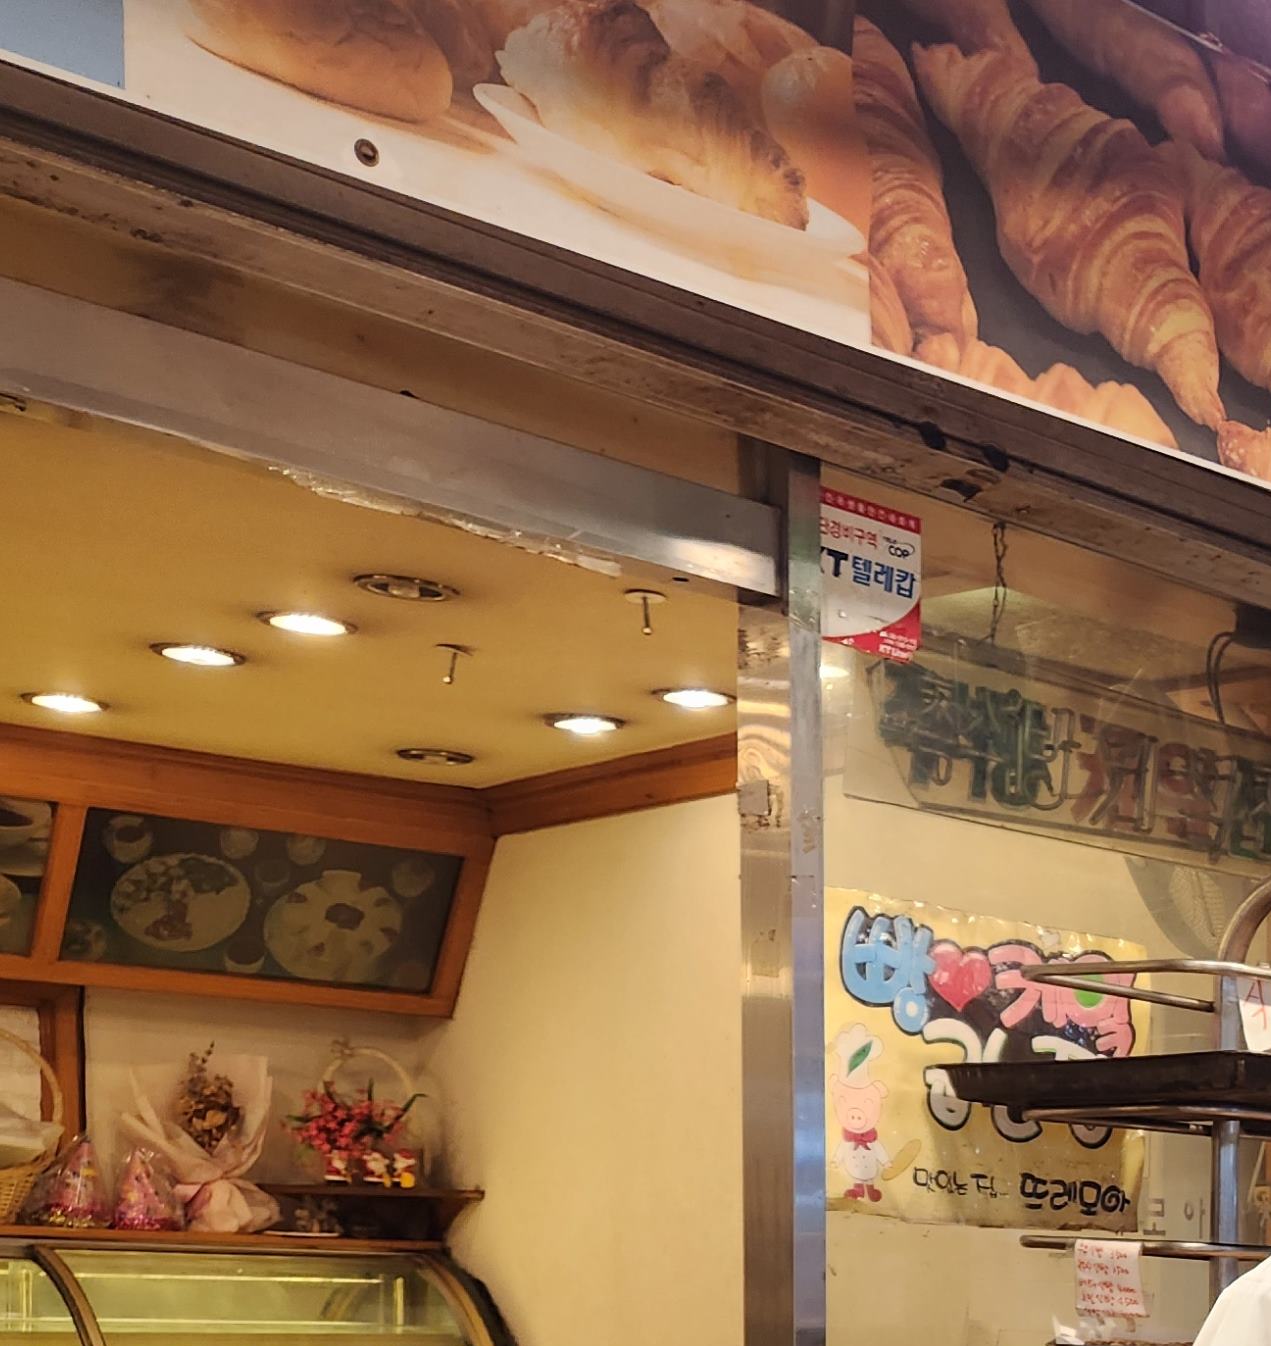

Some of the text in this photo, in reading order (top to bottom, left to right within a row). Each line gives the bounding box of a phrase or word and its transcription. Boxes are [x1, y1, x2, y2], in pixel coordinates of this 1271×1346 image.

[852, 556, 916, 600] 텔레캅
[840, 905, 936, 1036] 빵
[912, 1165, 969, 1196] 맛있는
